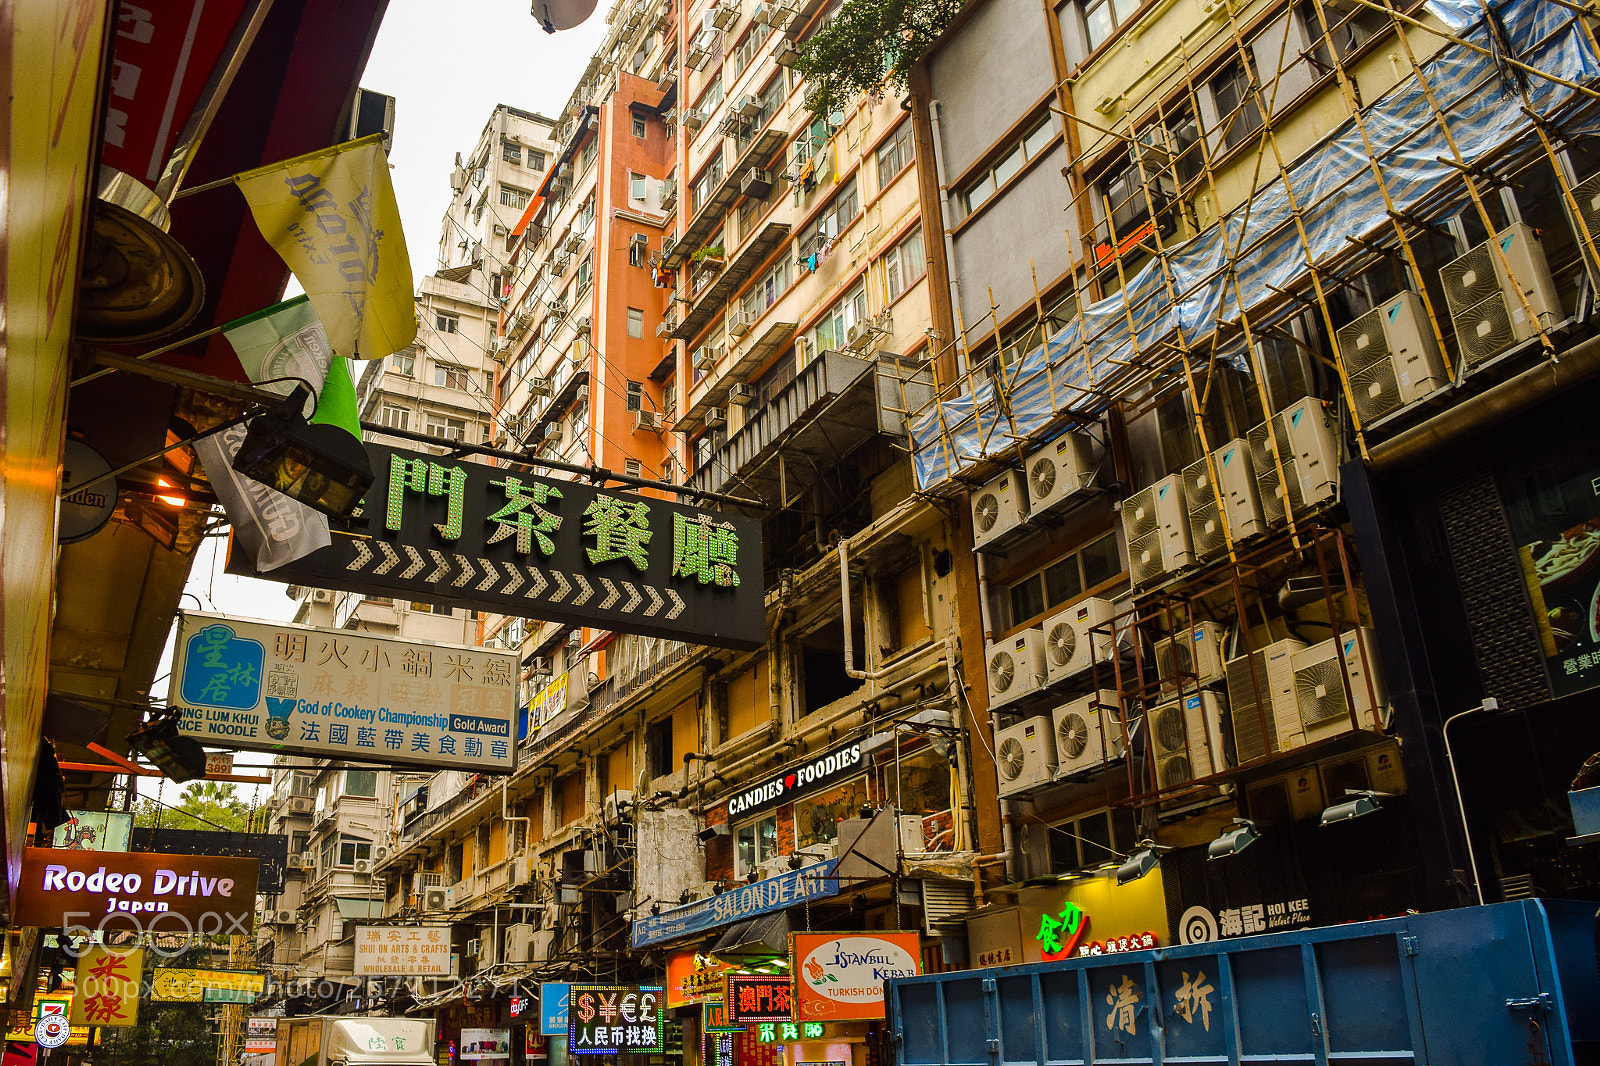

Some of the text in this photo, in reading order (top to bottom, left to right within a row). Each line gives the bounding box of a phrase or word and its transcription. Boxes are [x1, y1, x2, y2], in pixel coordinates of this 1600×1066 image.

[376, 453, 741, 588] 門茶餐廳
[272, 632, 512, 687] 明火小鍋米線
[181, 708, 259, 726] ING LUM KHUI
[208, 723, 258, 738] NOODLE
[297, 699, 449, 732] God of Cookery Championship
[453, 717, 507, 735] Gold Award
[299, 720, 508, 760] 法國藍帶美食勳章
[728, 744, 860, 815] CANDIES FOODIES
[42, 864, 235, 897] Rodeo Drive
[713, 883, 765, 922] SALON
[768, 876, 790, 906] DE
[793, 864, 828, 900] ART
[106, 898, 169, 914] Japan
[1218, 904, 1266, 937] 海記
[1267, 898, 1309, 916] HOI KEE
[1036, 901, 1081, 953] 食力
[359, 944, 448, 954] SHUI ON ARTS & CRAFTS
[363, 965, 442, 973] WHOLESALE & RETAIL
[83, 952, 132, 1024] 米線
[828, 988, 864, 997] TURKISH
